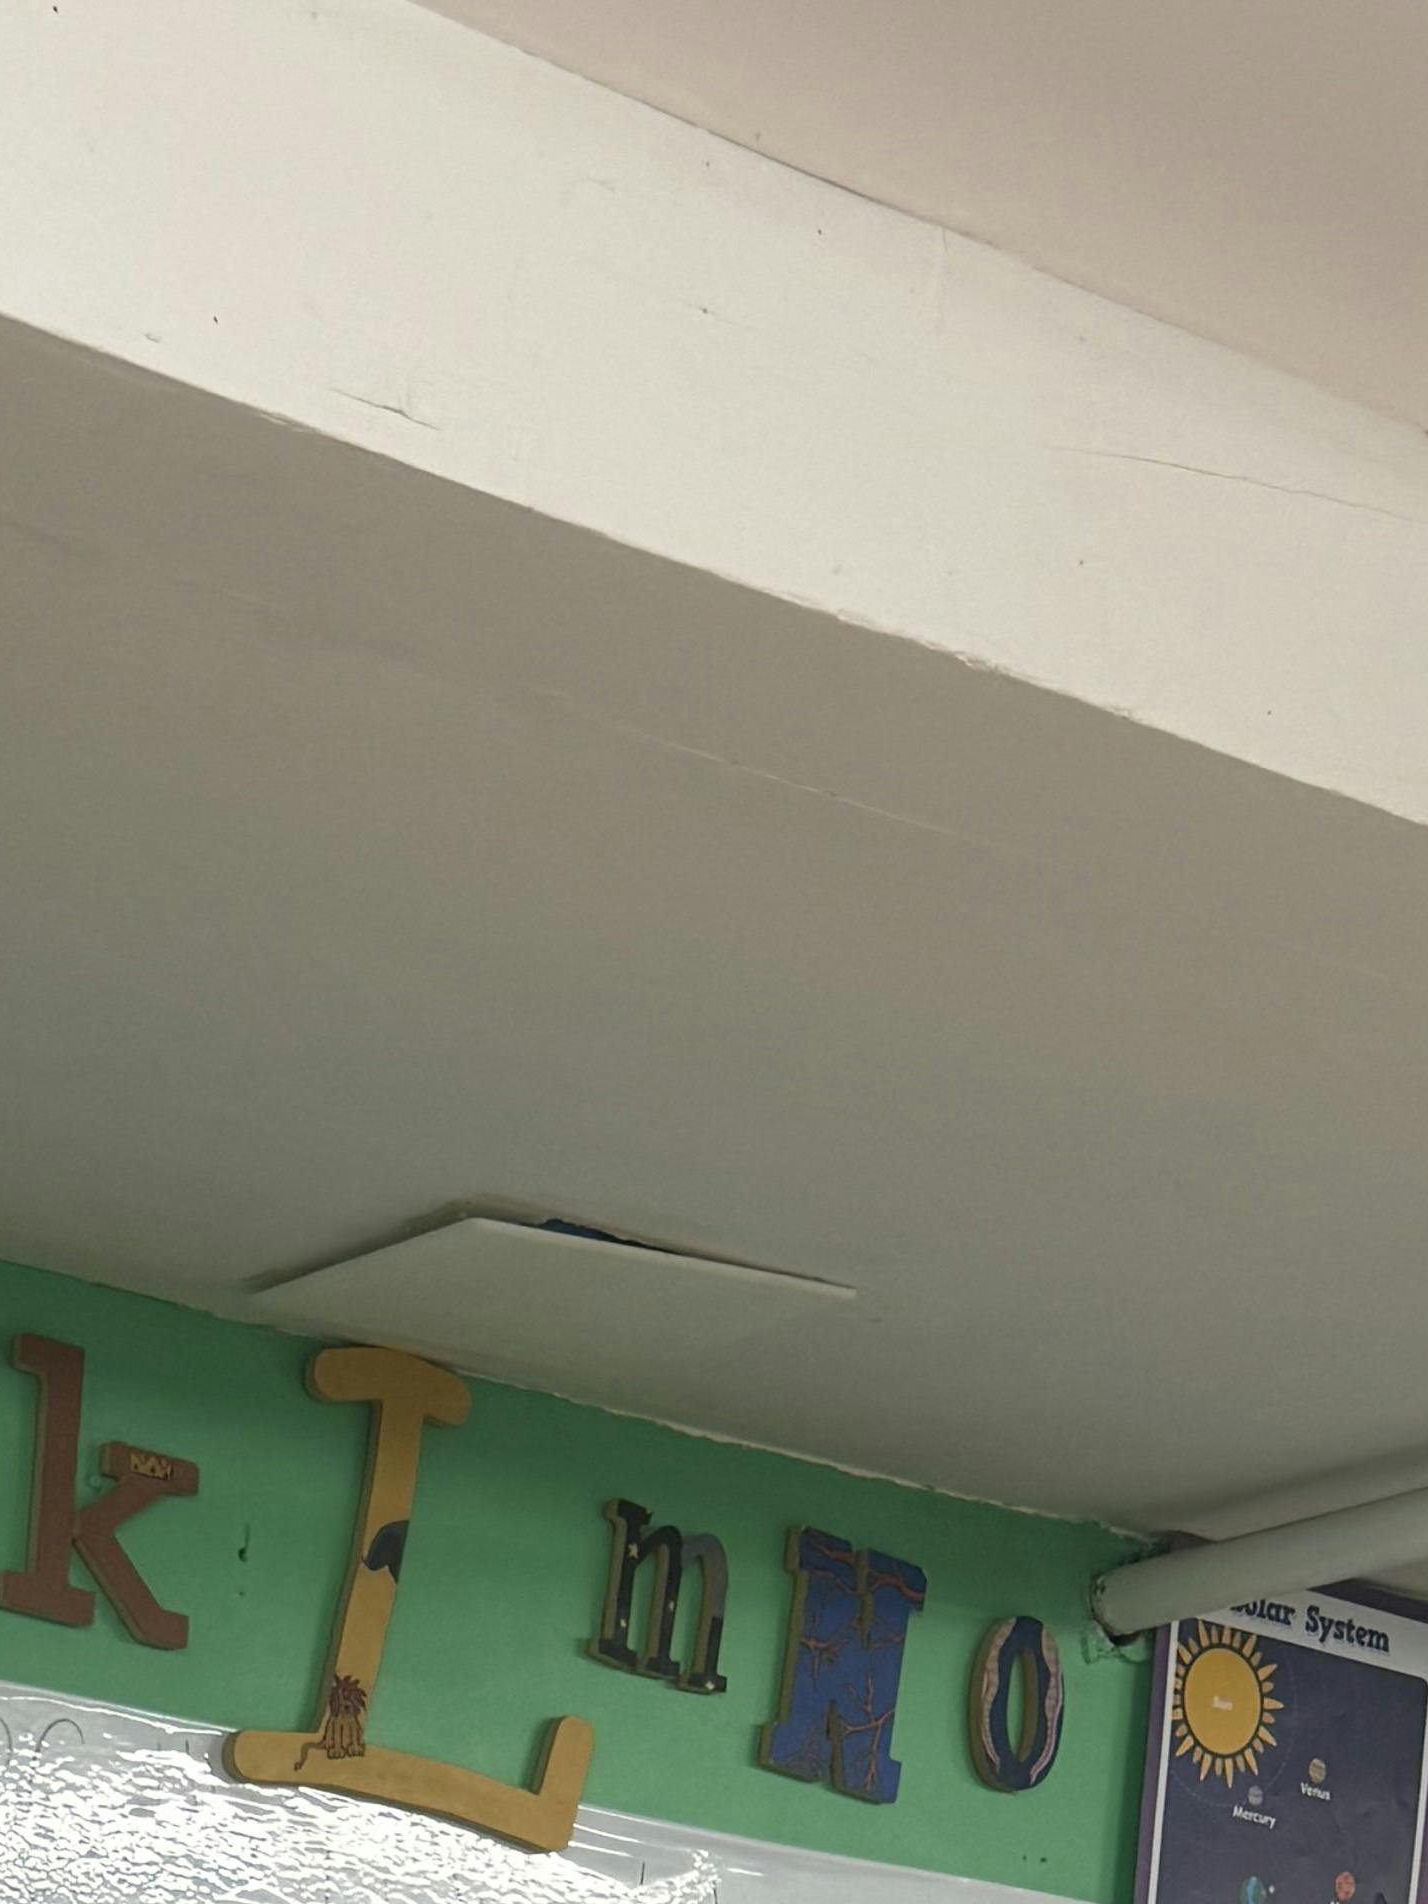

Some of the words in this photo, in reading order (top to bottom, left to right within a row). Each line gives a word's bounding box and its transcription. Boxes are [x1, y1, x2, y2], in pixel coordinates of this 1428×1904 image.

[586, 1497, 730, 1695] m
[1304, 1605, 1391, 1653] System
[1299, 1781, 1332, 1802] Venus
[1231, 1804, 1277, 1830] Mercury
